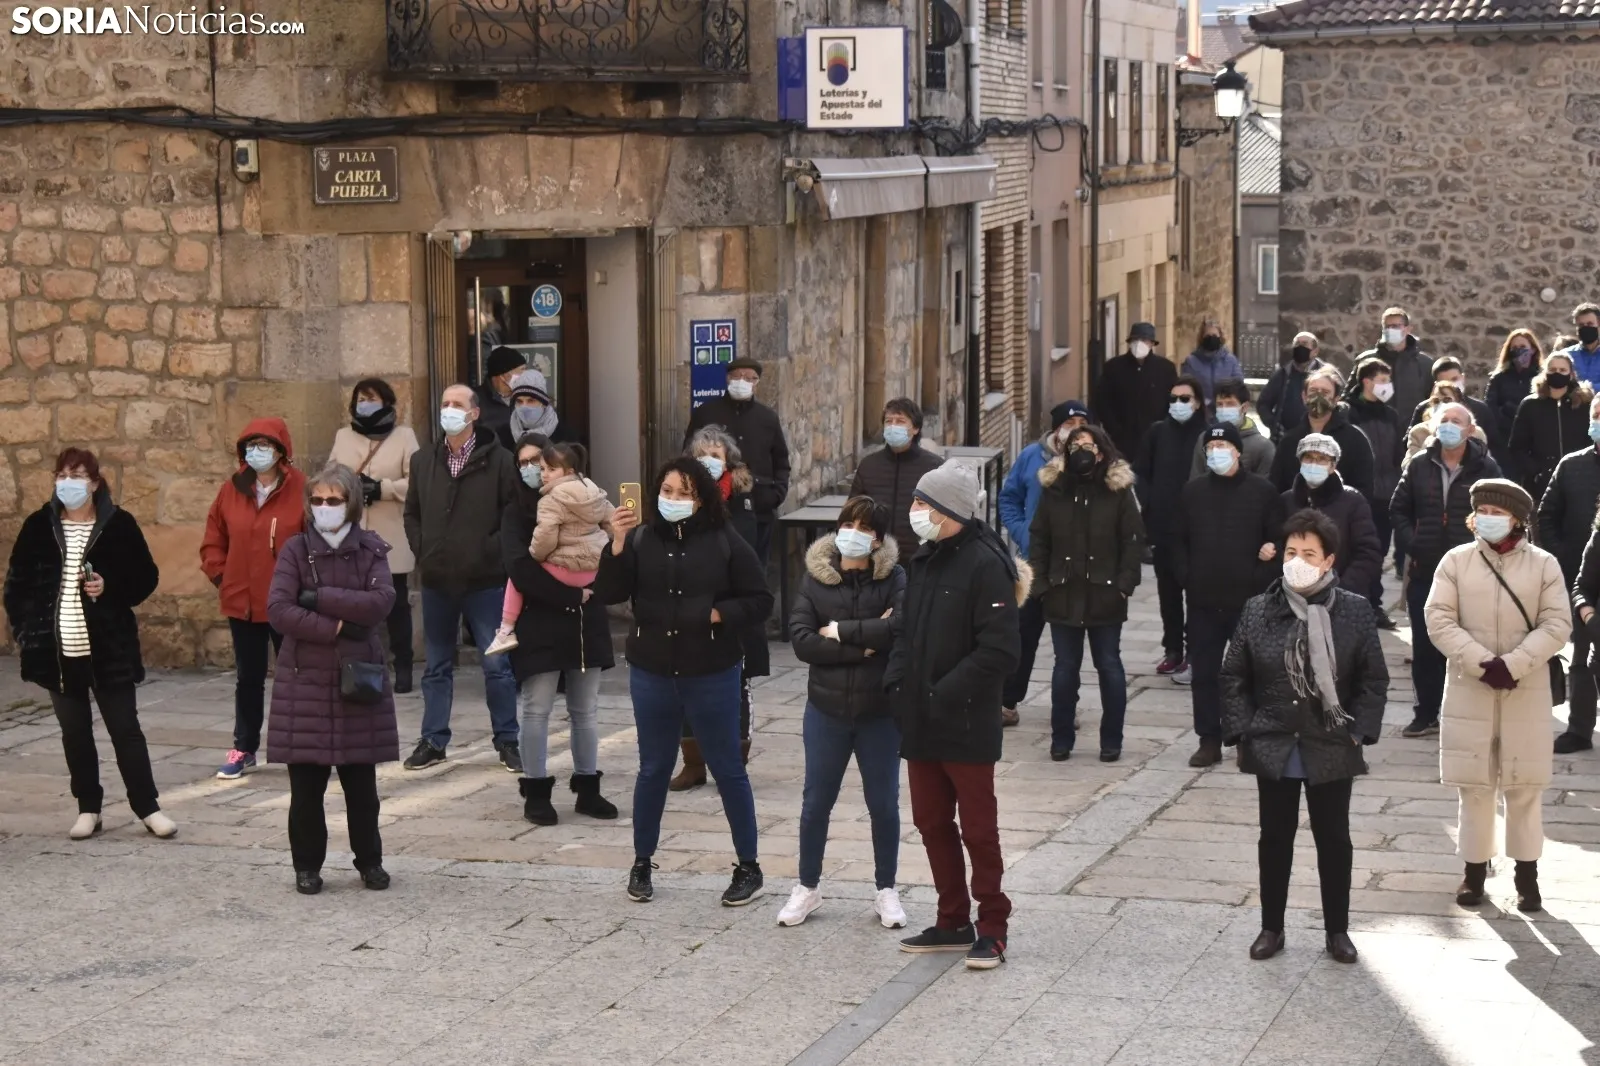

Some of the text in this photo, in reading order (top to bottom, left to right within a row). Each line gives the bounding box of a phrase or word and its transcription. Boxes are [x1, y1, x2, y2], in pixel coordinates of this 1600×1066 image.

[862, 90, 868, 99] y
[820, 99, 882, 110] Apuestas del
[820, 111, 853, 120] Estado
[338, 151, 376, 163] PLAZA
[334, 169, 381, 184] CARTA
[329, 184, 388, 198] PUEBLA
[720, 389, 726, 397] y
